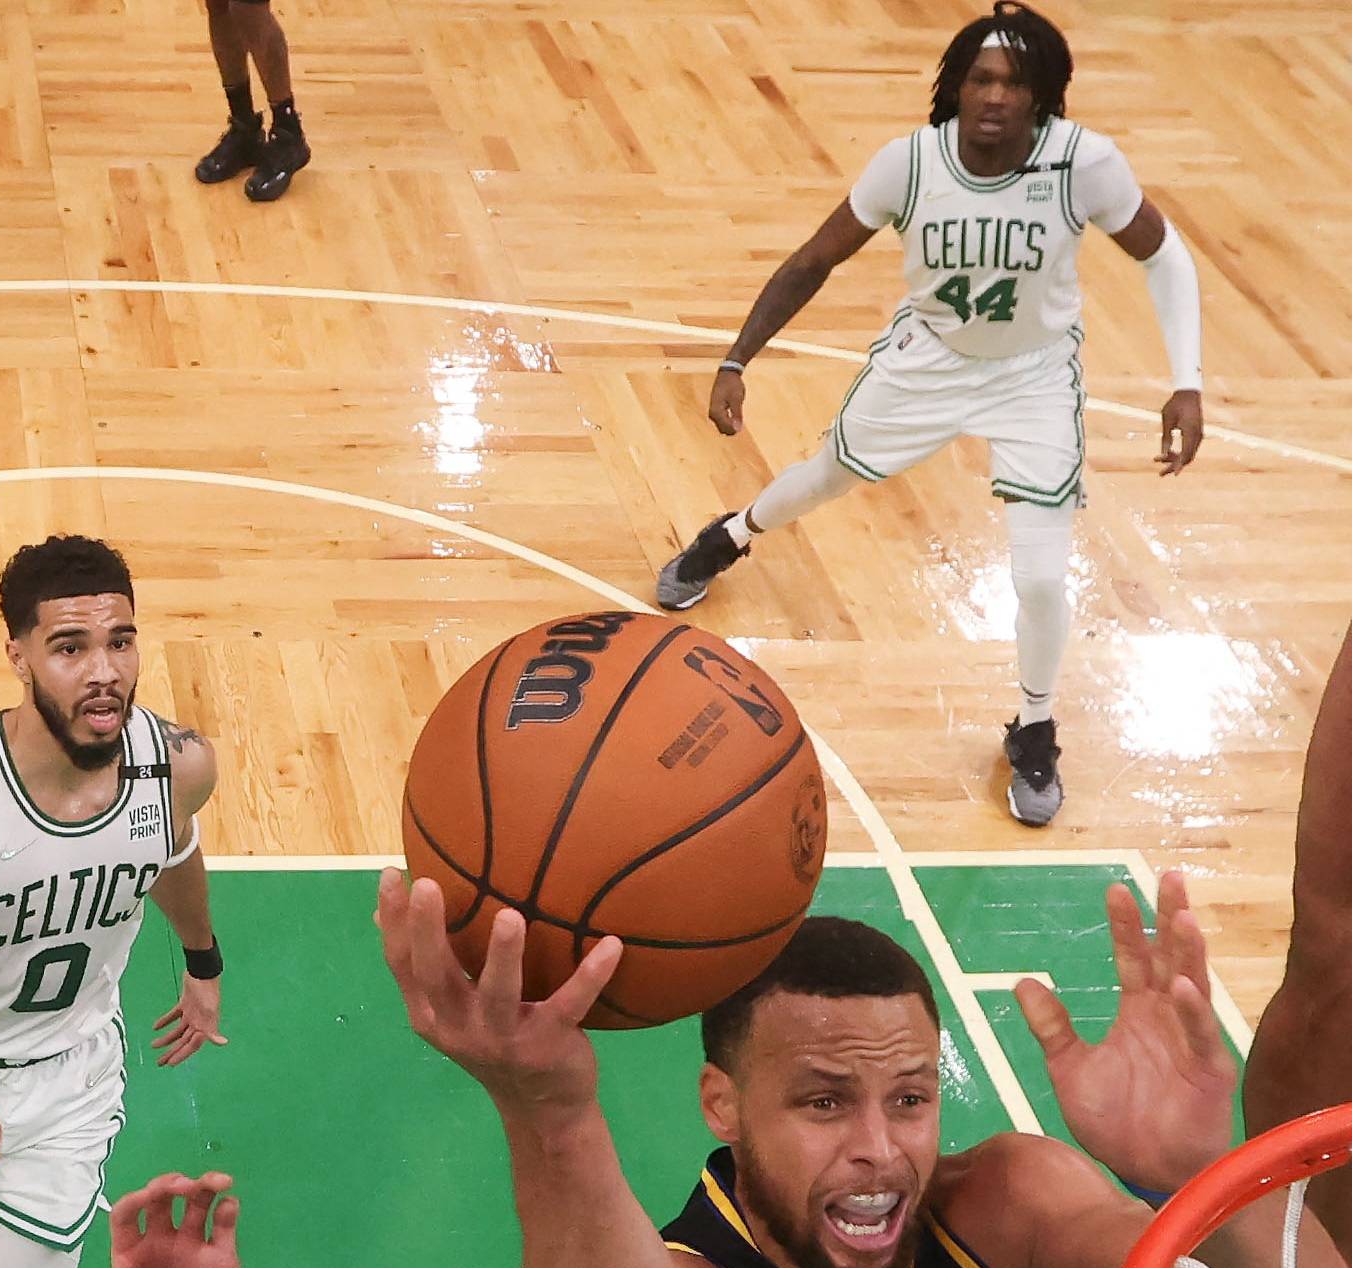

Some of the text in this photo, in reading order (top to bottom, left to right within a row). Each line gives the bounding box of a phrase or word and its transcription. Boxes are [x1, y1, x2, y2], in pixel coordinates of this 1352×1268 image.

[922, 216, 1046, 271] CELTICS
[934, 275, 1018, 323] 44
[138, 766, 153, 779] 24
[129, 804, 161, 826] VISTA
[130, 822, 161, 841] PRINT
[8, 942, 91, 1013] 0
